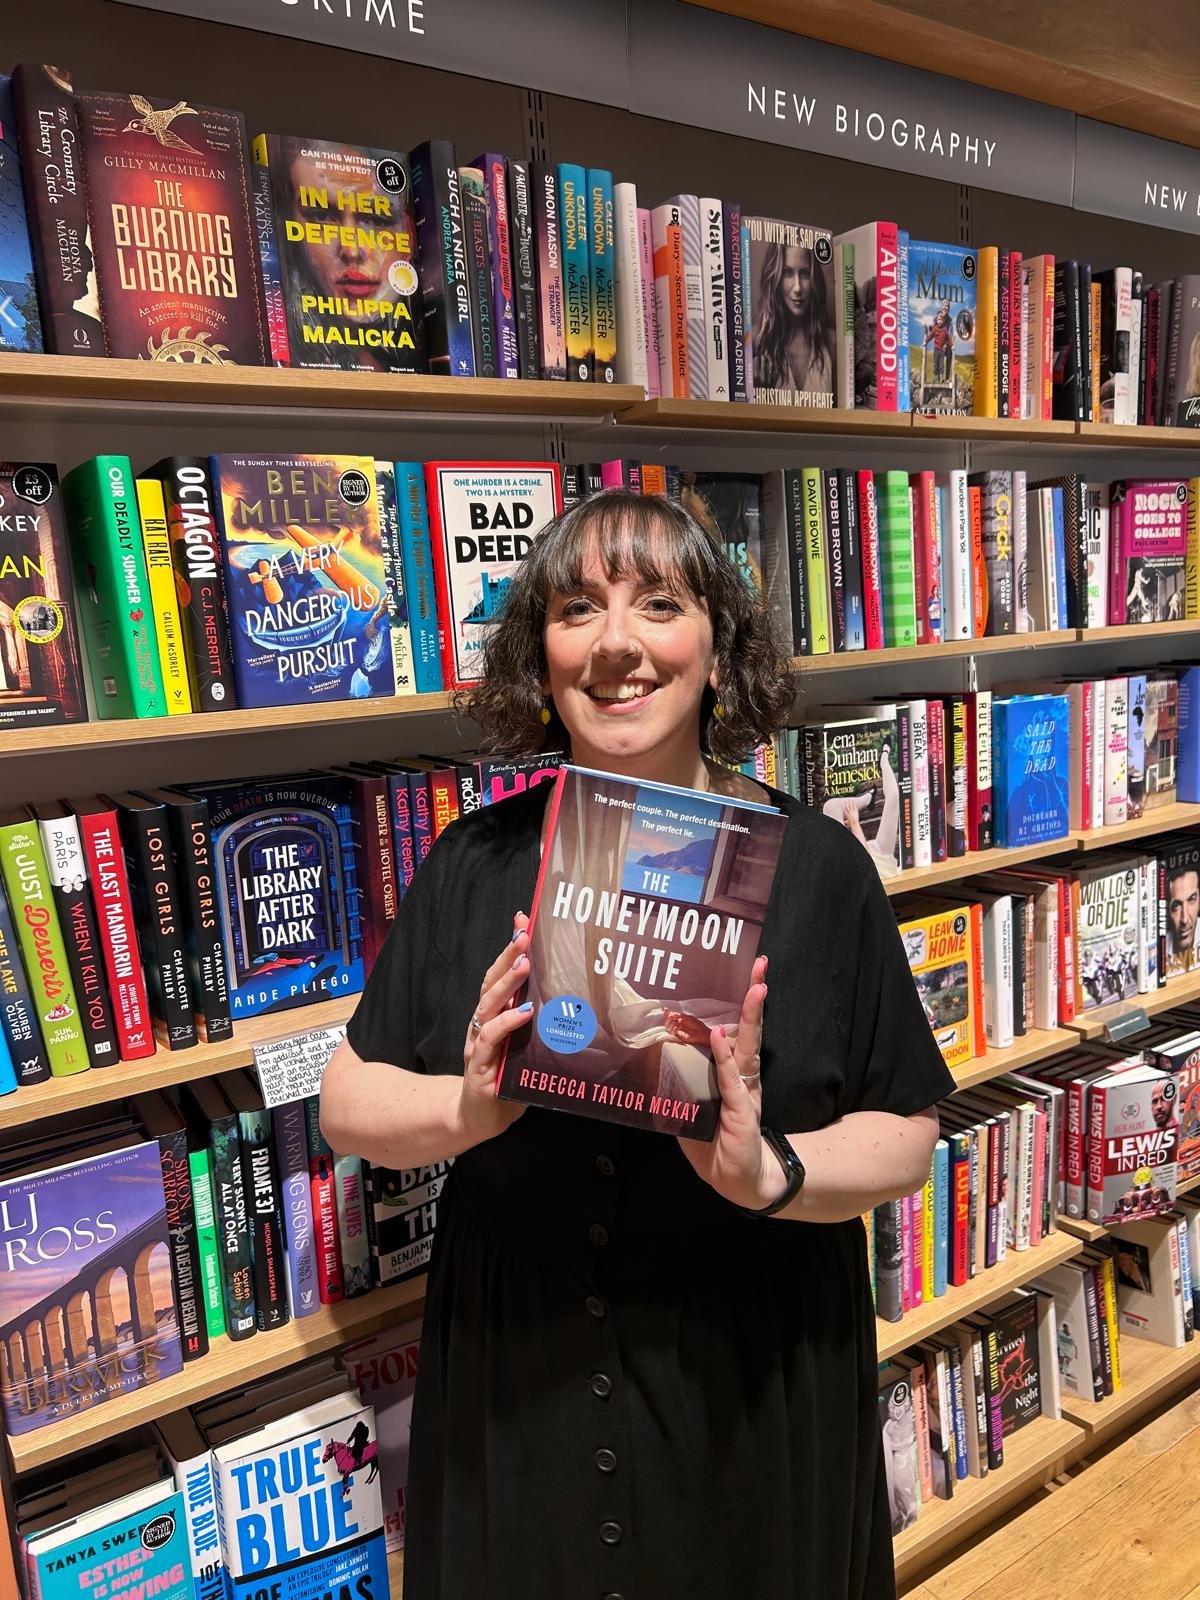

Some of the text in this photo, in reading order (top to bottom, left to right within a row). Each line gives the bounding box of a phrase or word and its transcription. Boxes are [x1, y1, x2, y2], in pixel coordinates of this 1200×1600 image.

[748, 82, 997, 167] NEW BIOGRAPHY
[37, 110, 65, 205] Library Circle
[103, 154, 227, 180] GILLY MACMILLAN
[315, 161, 371, 176] BE TRUSTED?
[153, 179, 185, 208] THE
[300, 185, 392, 217] IN HER
[563, 180, 577, 250] UNKNOWN
[1145, 182, 1187, 212] NEW
[111, 203, 234, 256] BURNING
[285, 220, 411, 254] DEFENCE
[544, 174, 558, 269] SIMON MASON
[592, 187, 605, 255] UNKNOWN
[55, 218, 73, 282] MACLEAN
[68, 228, 82, 275] SHONA
[440, 206, 455, 285] ANDREA MARA
[730, 212, 741, 280] STARCHILD
[116, 248, 238, 299] LIBRARY
[900, 245, 909, 347] THE ILLUMINATED MAN
[915, 272, 965, 304] Mum
[301, 295, 412, 321] PHILIPPA
[579, 275, 590, 326] GILLIAN
[672, 231, 687, 377] Diary Secret Drug Addict
[733, 283, 744, 336] MAGGIE
[880, 247, 898, 373] ATWOOD
[1001, 286, 1009, 347] ABSENCE
[302, 325, 416, 350] MALICKA
[735, 339, 745, 386] ADERIN
[1002, 353, 1010, 394] BUDGIE
[266, 469, 335, 495] BEN
[519, 479, 543, 487] CRIME.
[109, 467, 141, 605] OUR DEADLY SUMMER
[176, 466, 218, 580] OCTAGON
[469, 501, 534, 530] BAD
[807, 478, 820, 560] DAVID BOWIE
[828, 476, 843, 587] BOBBI BROWN
[866, 480, 879, 591] GORDON BROWN
[995, 493, 1012, 562] Crick
[1134, 511, 1182, 525] GOES TO
[1134, 526, 1182, 539] COLLEGE
[144, 518, 171, 569] RAT RACE
[268, 540, 345, 580] A VERY
[245, 584, 376, 636] DANGEROUS
[277, 637, 358, 683] PURSUIT
[420, 629, 430, 665] MULLEN
[427, 634, 436, 659] KELLY
[823, 731, 856, 751] Lena
[913, 721, 923, 760] BREAK
[979, 702, 988, 782] RULE LIES
[1025, 719, 1055, 738] SAID
[1028, 738, 1053, 755] THE
[823, 746, 880, 769] Dunham
[823, 760, 882, 787] Famesick
[1023, 759, 1057, 775] DEAD
[594, 793, 751, 835] The perfect couple. The perfect destination.
[641, 819, 696, 839] The perfect lie.
[917, 812, 926, 841] ELKIN
[191, 822, 215, 929] LOST GIRLS
[262, 844, 301, 872] THE
[92, 828, 134, 979] THE LAST MANDARIN
[146, 827, 175, 936] LOST GIRLS
[242, 865, 324, 901] LIBRARY
[642, 870, 671, 894] THE
[15, 853, 64, 999] JUST Desserts
[70, 901, 92, 952] WHEN
[257, 893, 317, 925] AFTER
[552, 881, 744, 956] HONEYMOON
[1087, 896, 1130, 930] OR DIE
[1159, 899, 1167, 937] DRIVE
[261, 918, 317, 949] DARK
[928, 934, 966, 961] HOME
[81, 963, 100, 995] KILL
[173, 949, 189, 1011] CHARLOTTE
[213, 942, 227, 1003] CHARLOTTE
[593, 938, 683, 990] SUITE
[86, 995, 106, 1030] YOU
[234, 973, 350, 1009] ANDE PLIEGO
[546, 1027, 585, 1041] LONGLISTED
[553, 1016, 583, 1028] WOMEN'S
[557, 1022, 576, 1032] PRIZE
[519, 1068, 701, 1123] REBECCA TAYLOR MCKAY
[1067, 1090, 1080, 1179] LEWIS IN RED
[1089, 1093, 1104, 1184] LEWIS IN RED
[1108, 1127, 1176, 1160] LEWIS
[251, 1148, 275, 1214] FRAME 37
[1117, 1150, 1168, 1172] IN RED
[9, 1187, 22, 1195] THE
[160, 1150, 180, 1225] SCARROW
[232, 1156, 248, 1234] VERY SLOWLY
[2, 1192, 39, 1236] LJ
[221, 1183, 239, 1254] ALL AT ONCE
[5, 1210, 118, 1273] ROSS
[25, 1344, 168, 1412] BERWICK
[231, 1439, 326, 1511] TRUE
[236, 1478, 360, 1577] BLUE
[45, 1547, 97, 1574] TANYA
